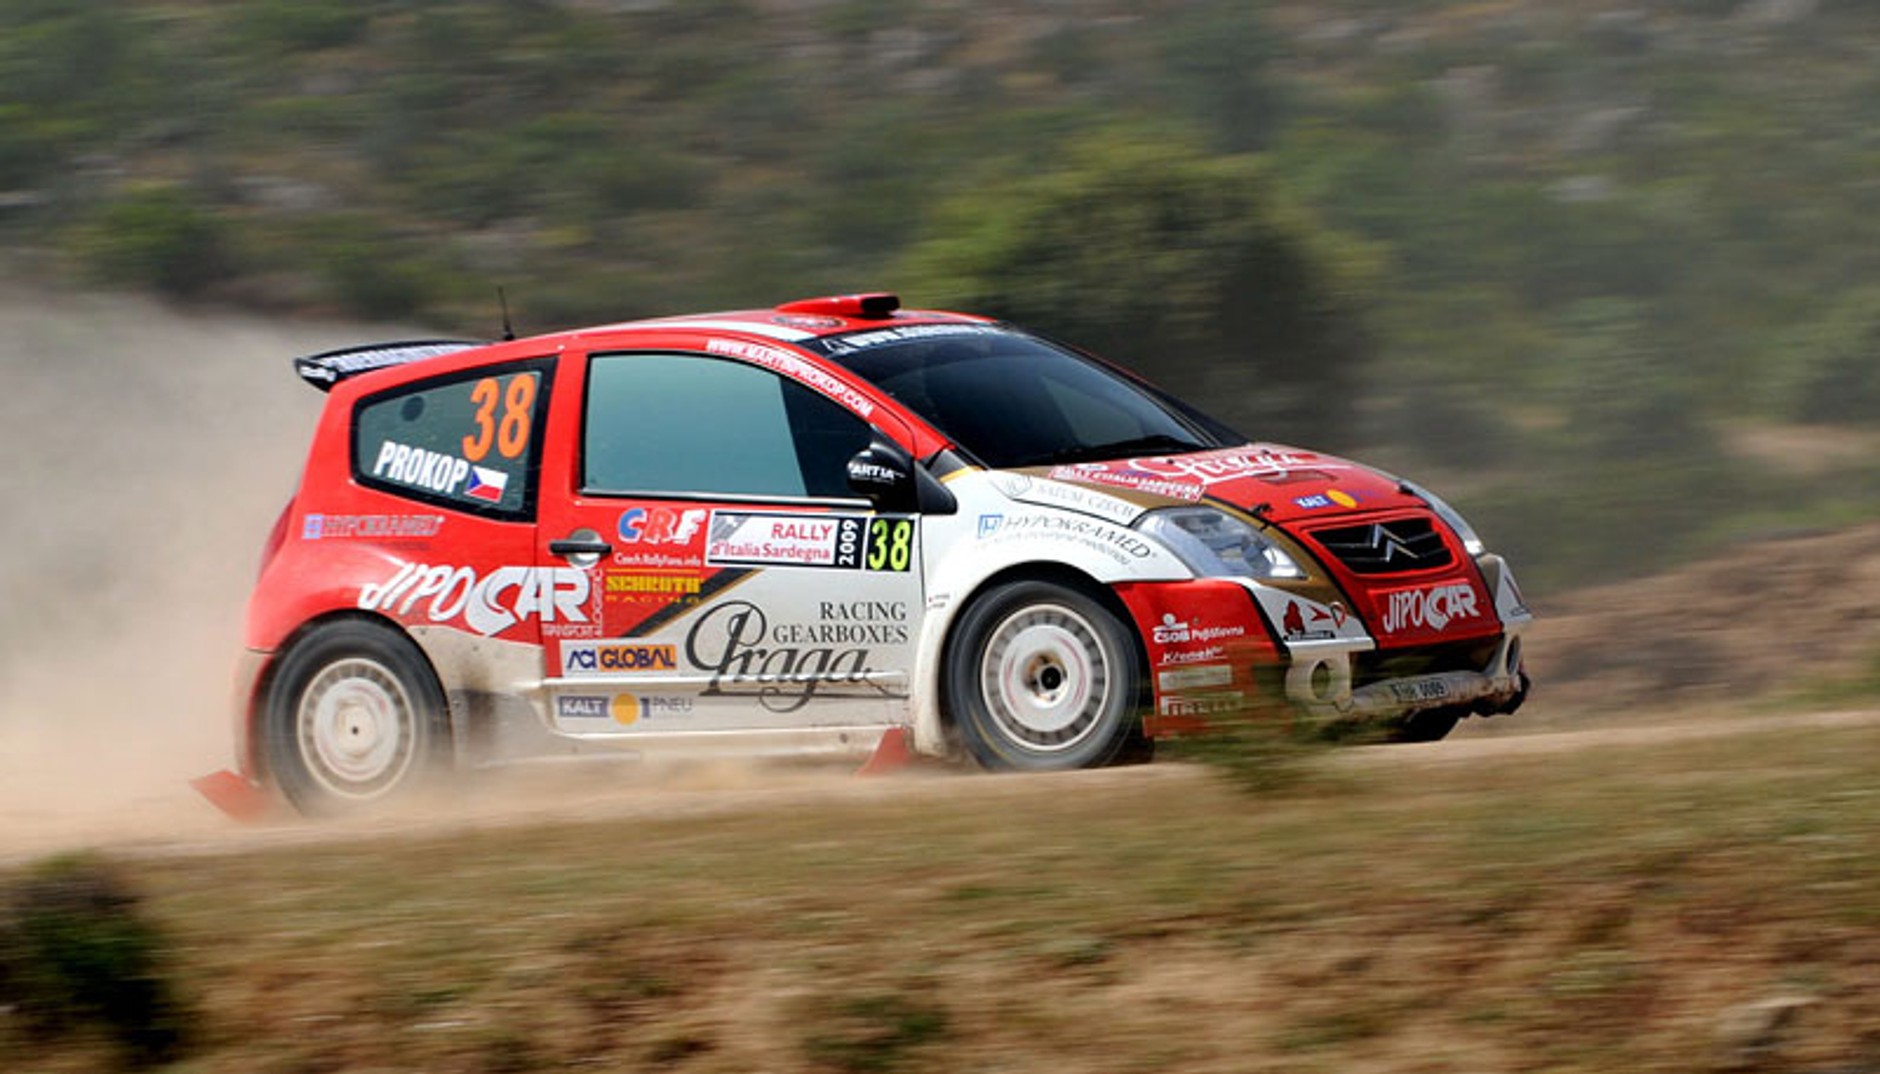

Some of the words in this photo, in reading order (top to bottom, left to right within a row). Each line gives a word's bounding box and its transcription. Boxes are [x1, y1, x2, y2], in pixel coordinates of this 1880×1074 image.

[463, 373, 535, 462] 38
[373, 441, 469, 493] PROKOP
[618, 508, 706, 544] CRF
[771, 523, 833, 541] RALLY
[839, 519, 860, 566] 2009
[868, 519, 911, 571] 38
[711, 541, 760, 557] d'Italia
[761, 543, 831, 563] Sardegna
[357, 563, 590, 637] JIPOCAR
[820, 602, 906, 621] RACING
[1382, 584, 1480, 633] JIPOCAR
[773, 625, 908, 645] GEARBOXES
[600, 649, 676, 668] GLOBAL
[686, 600, 909, 713] Praga
[562, 699, 604, 714] KALT
[653, 697, 692, 711] PNEU
